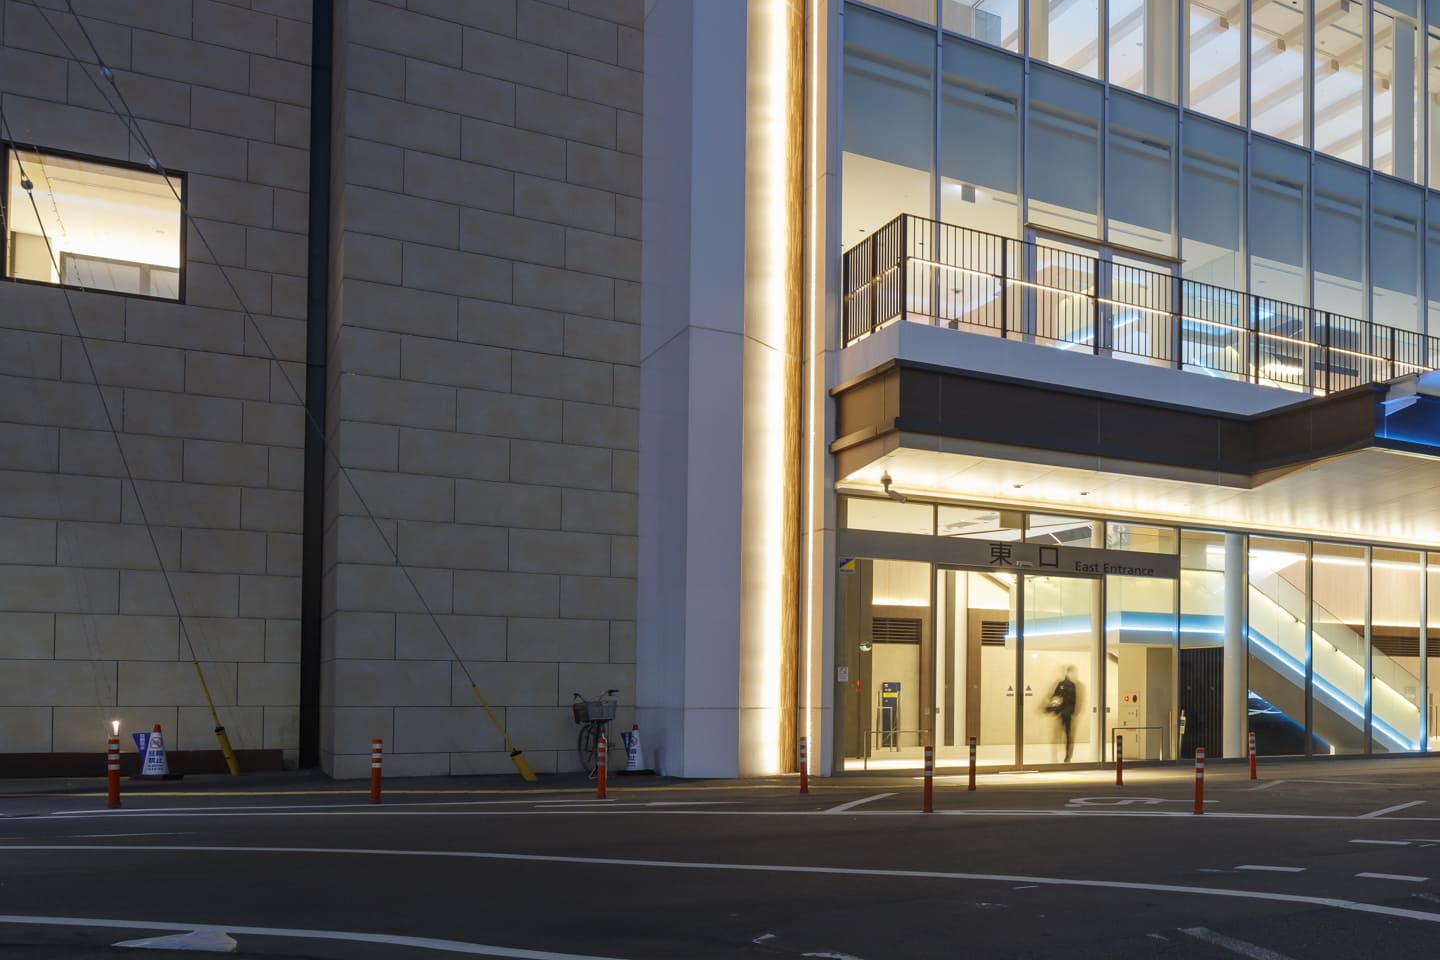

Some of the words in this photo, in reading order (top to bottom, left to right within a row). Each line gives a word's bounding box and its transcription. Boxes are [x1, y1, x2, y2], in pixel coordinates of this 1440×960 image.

[989, 542, 1059, 569] 東口
[1075, 560, 1100, 573] East
[1103, 562, 1154, 577] Entrance
